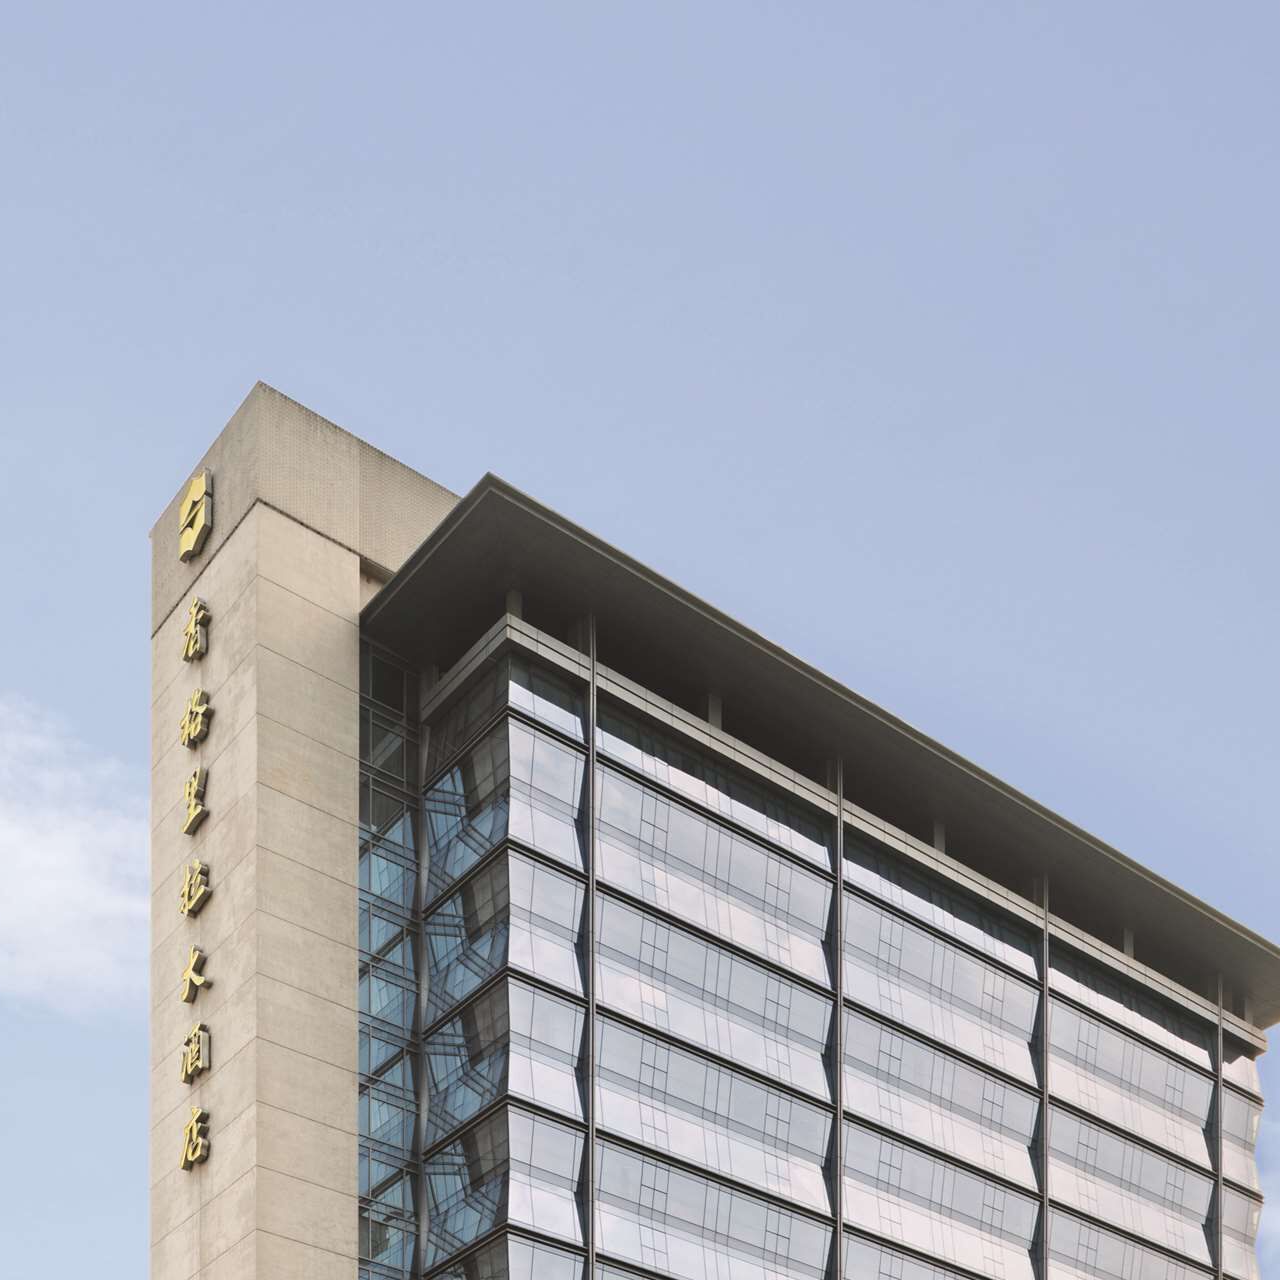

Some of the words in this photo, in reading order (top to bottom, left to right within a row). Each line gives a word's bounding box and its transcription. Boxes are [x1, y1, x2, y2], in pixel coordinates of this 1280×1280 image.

[180, 597, 212, 1171] 香格里拉大酒店
